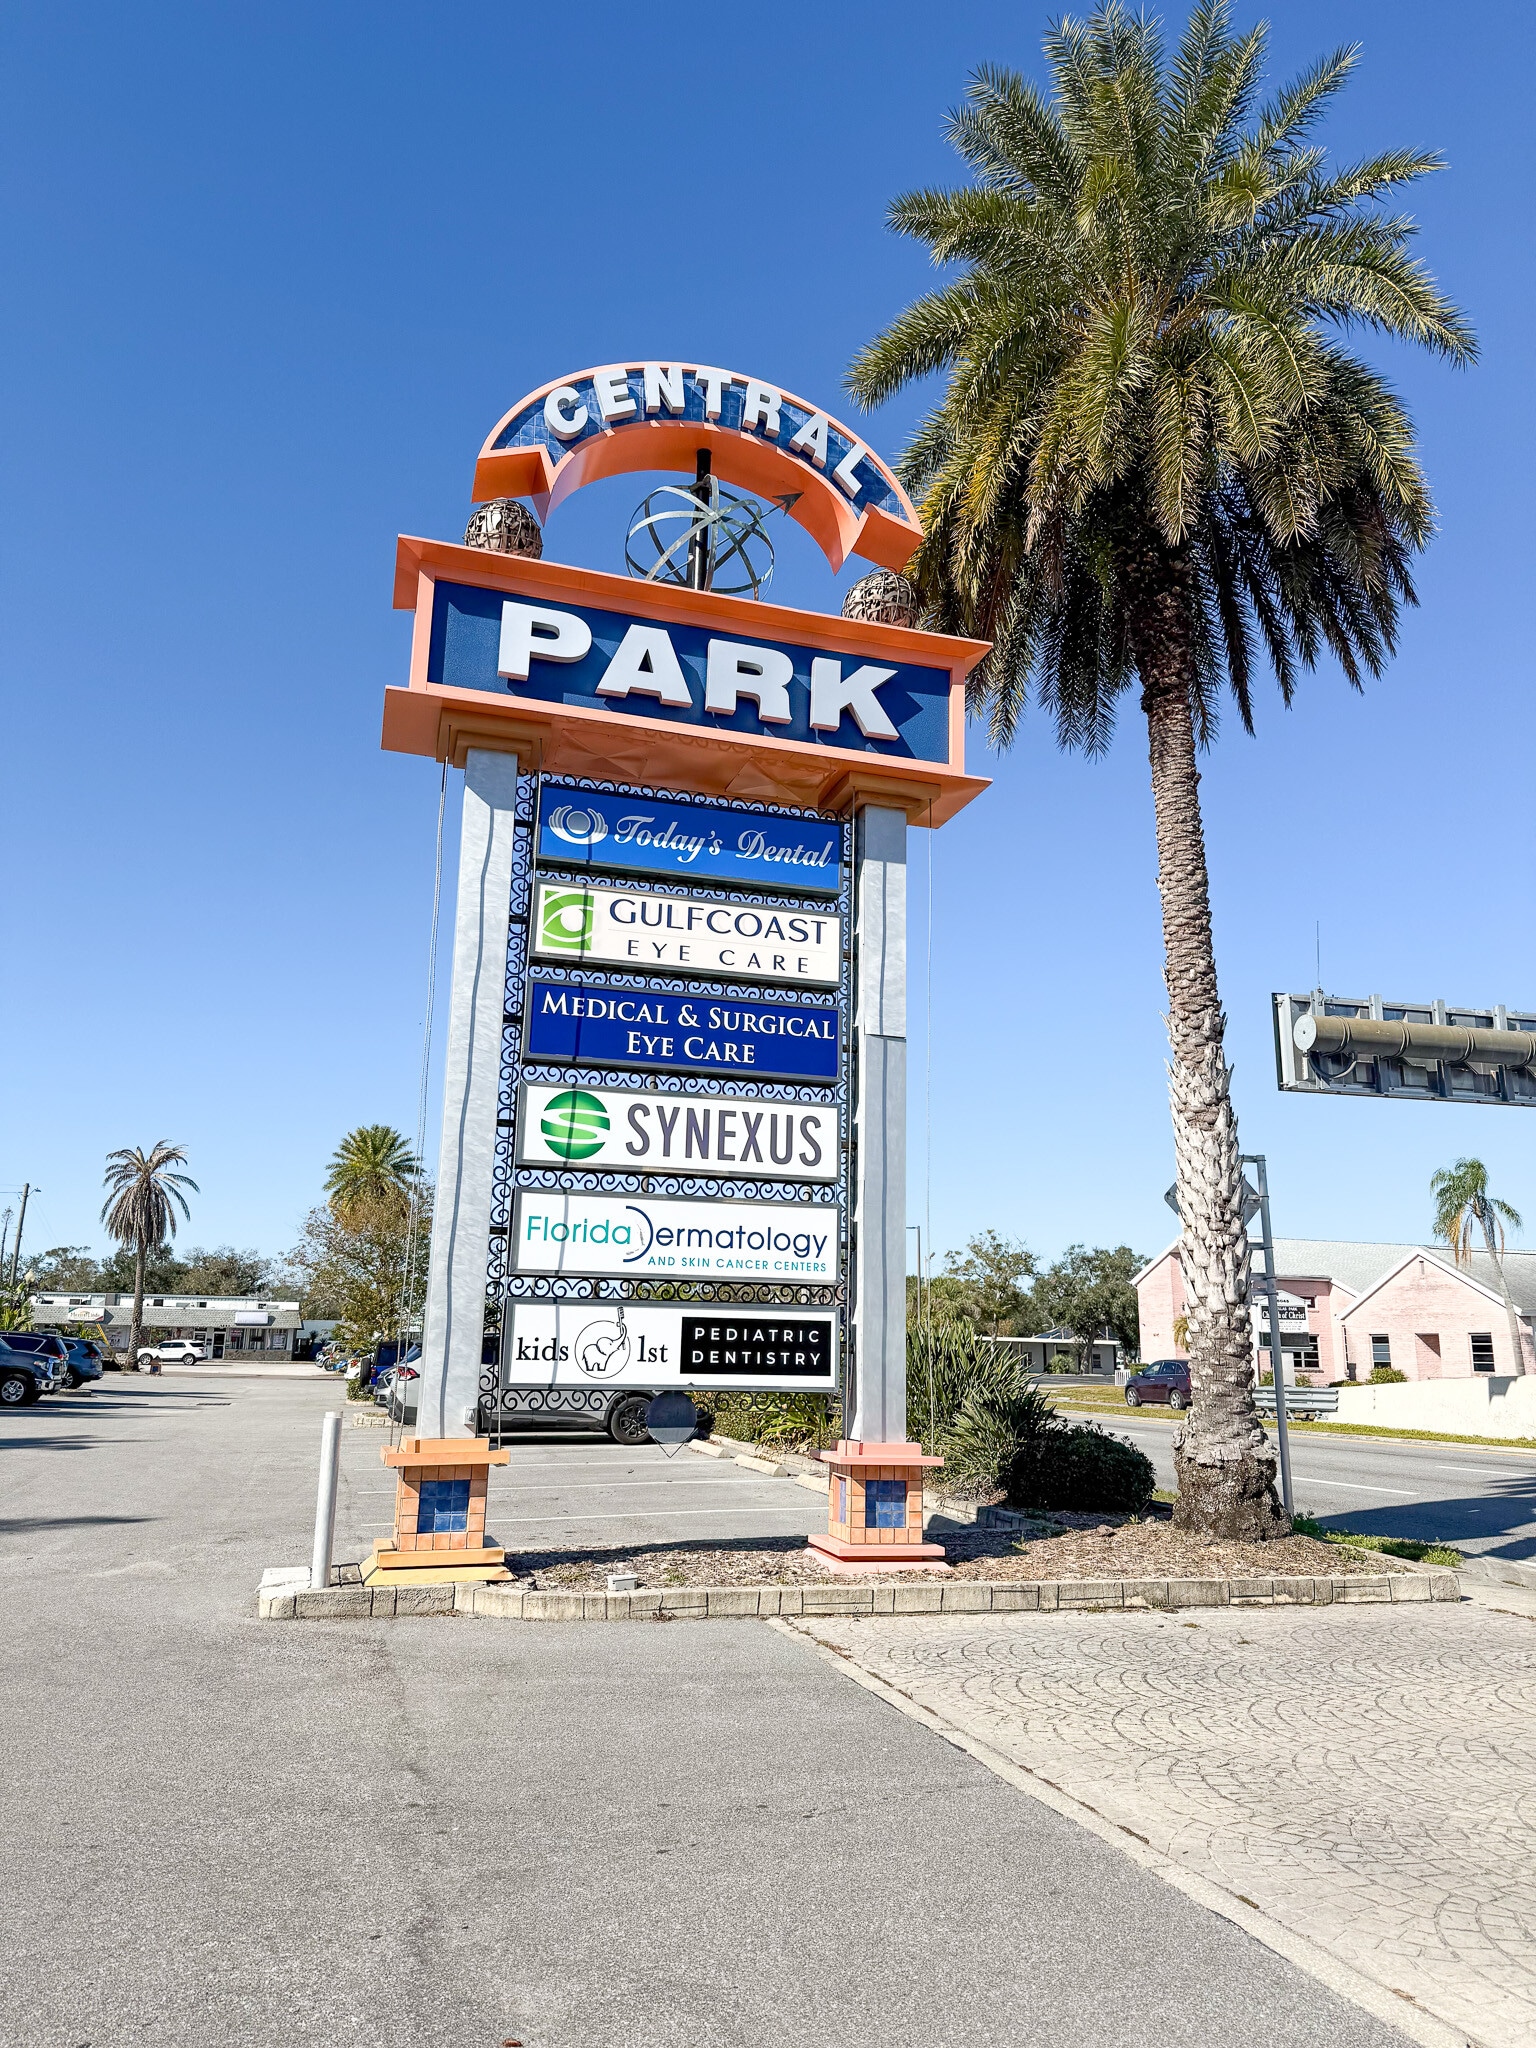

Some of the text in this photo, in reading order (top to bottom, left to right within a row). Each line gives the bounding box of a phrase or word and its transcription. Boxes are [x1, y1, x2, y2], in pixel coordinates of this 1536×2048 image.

[543, 364, 873, 499] CENTRAL
[497, 600, 899, 740] PARK
[614, 815, 834, 868] Today's Dental
[609, 898, 827, 945] GULFCOAST
[627, 939, 809, 974] EYE CARE
[541, 991, 835, 1040] MEDICAL & SURGICAL
[626, 1030, 755, 1064] EYE CARE
[625, 1103, 822, 1167] SYNEXUS
[526, 1215, 632, 1245] Florida
[648, 1256, 827, 1272] AND SKIN CANCER CENTERS
[1288, 1311, 1305, 1319] Christ
[515, 1335, 668, 1363] kids 1st
[694, 1327, 820, 1343] PEDIATRIC
[692, 1349, 821, 1366] DENTISTRY
